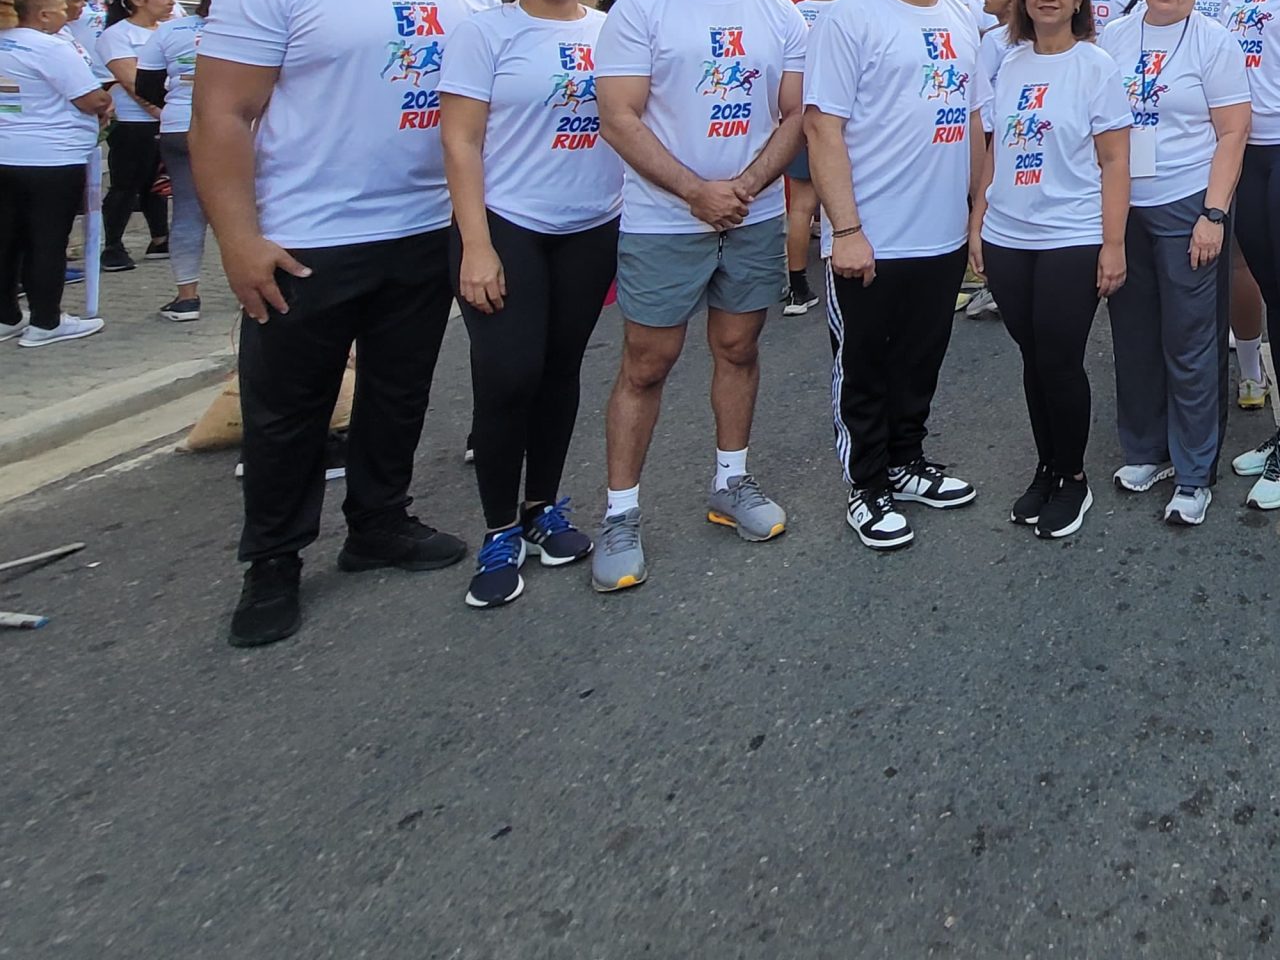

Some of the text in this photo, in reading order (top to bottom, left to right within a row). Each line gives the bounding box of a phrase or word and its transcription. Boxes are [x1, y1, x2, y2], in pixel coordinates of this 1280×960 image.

[1238, 39, 1263, 54] 025
[1245, 54, 1262, 68] UN
[401, 90, 440, 110] 202
[710, 102, 752, 120] 2025
[935, 107, 967, 125] 2025
[1131, 111, 1160, 126] 025
[556, 116, 600, 133] 2025
[707, 120, 750, 138] RUN
[551, 133, 599, 150] RUN
[932, 126, 966, 144] RUN
[1015, 152, 1043, 170] 2025
[1014, 169, 1042, 186] RUN
